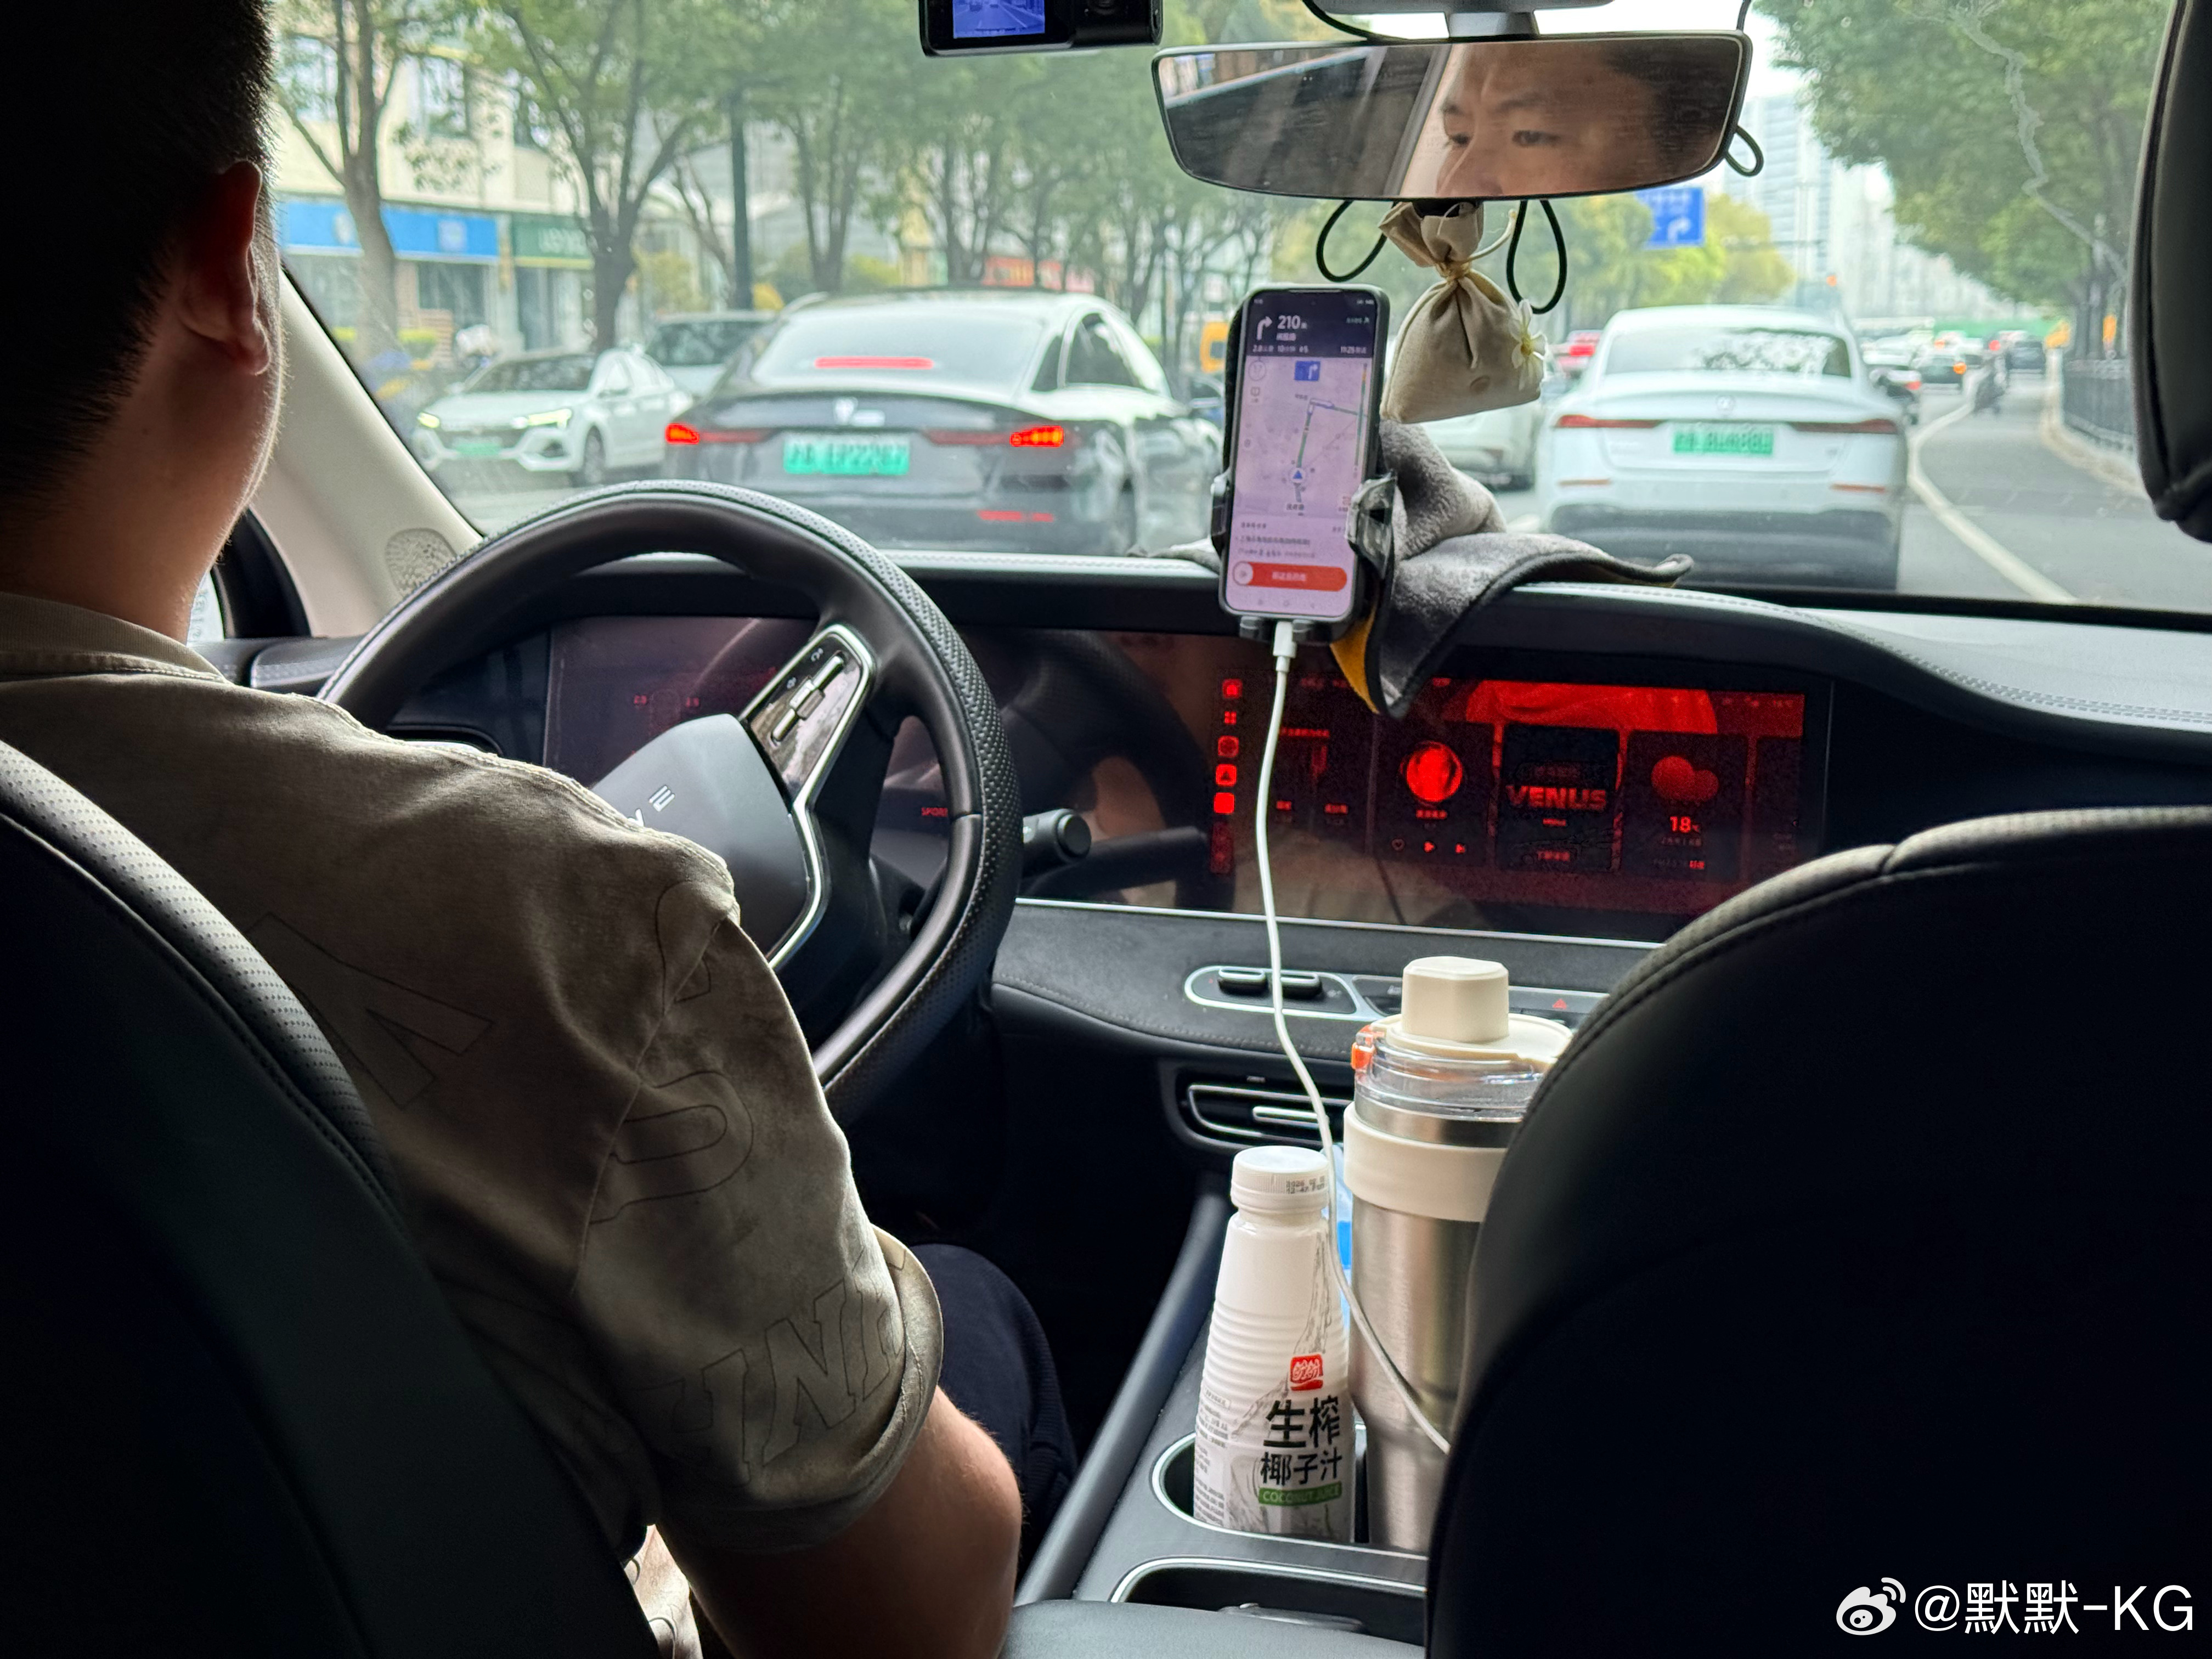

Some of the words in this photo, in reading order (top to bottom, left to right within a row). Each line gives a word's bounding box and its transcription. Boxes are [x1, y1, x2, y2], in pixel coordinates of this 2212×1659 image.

[1505, 785, 1607, 812] VENUS
[1263, 1395, 1340, 1448] 生榨
[1260, 1447, 1342, 1486] 椰子汁
